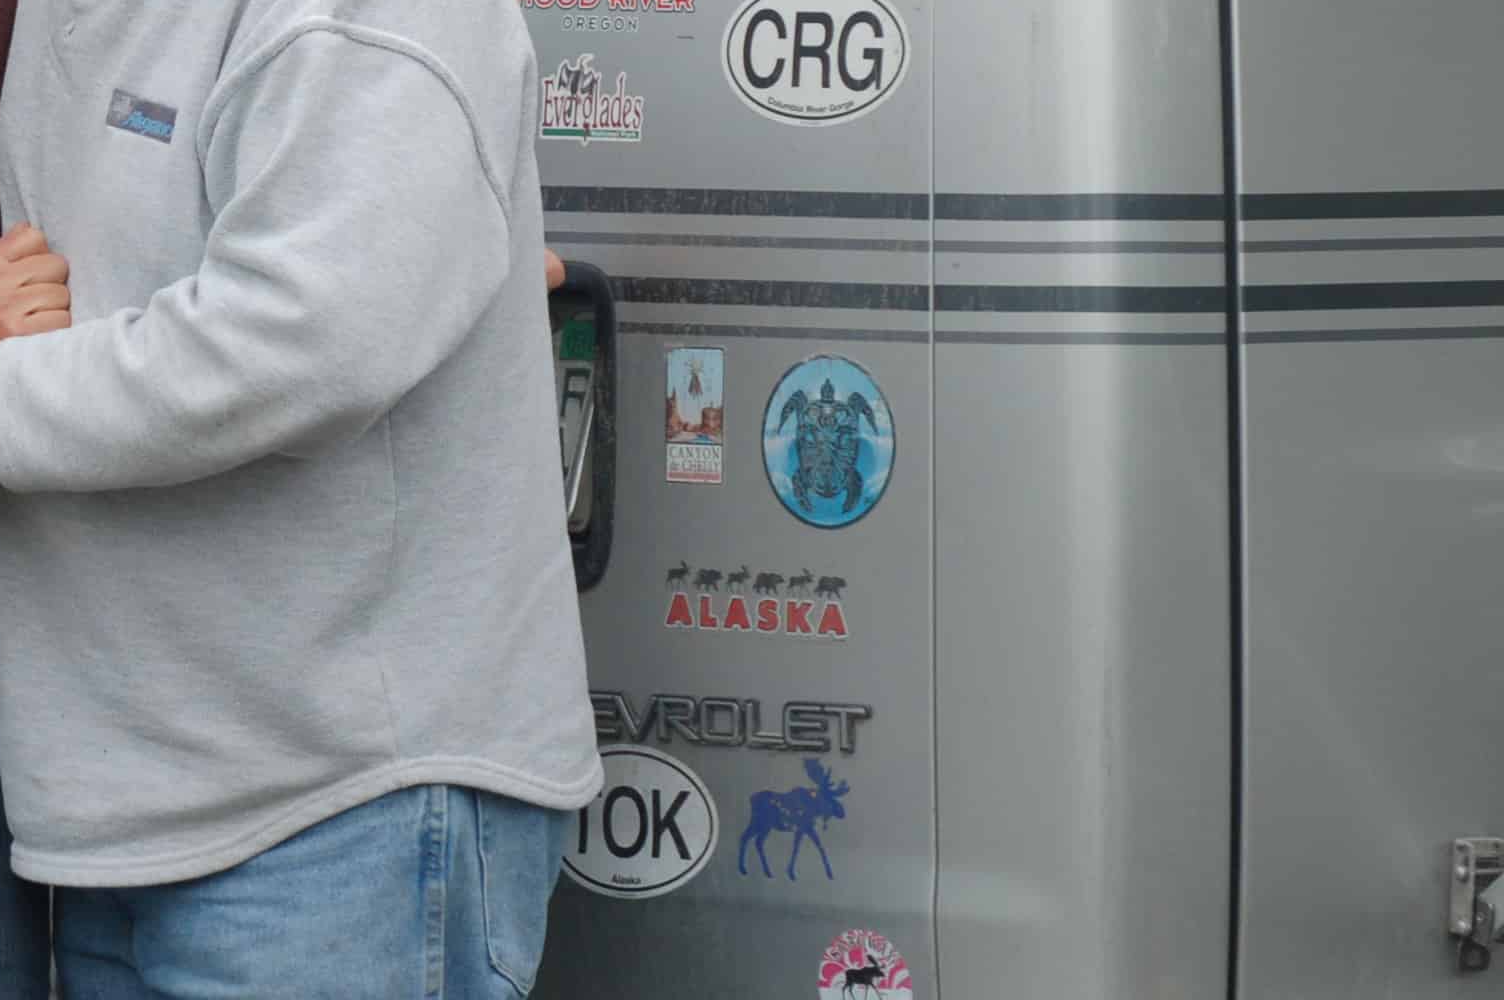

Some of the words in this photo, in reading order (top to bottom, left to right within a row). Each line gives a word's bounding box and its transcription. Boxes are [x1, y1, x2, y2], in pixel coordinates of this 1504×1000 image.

[561, 14, 640, 32] OREGON
[743, 9, 885, 92] CRG
[542, 74, 643, 130] Everglades
[669, 446, 721, 460] CANYON
[664, 593, 848, 638] ALASKA
